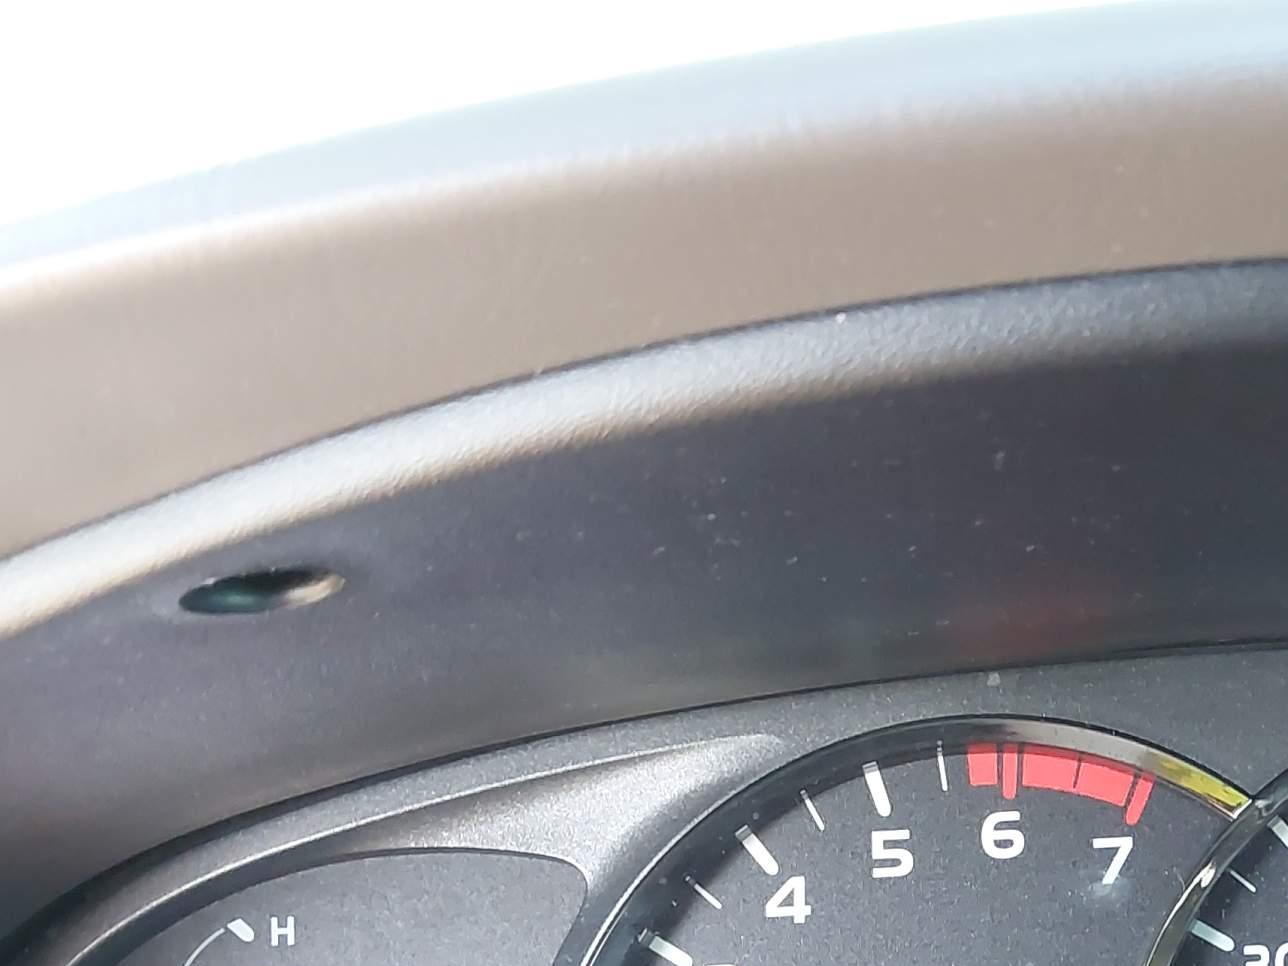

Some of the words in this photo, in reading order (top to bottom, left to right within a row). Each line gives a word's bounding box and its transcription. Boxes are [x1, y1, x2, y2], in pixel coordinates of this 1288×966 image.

[870, 828, 914, 879] 5
[980, 810, 1025, 859] 6
[1091, 836, 1134, 886] 7
[765, 875, 812, 924] 4
[270, 916, 296, 947] H
